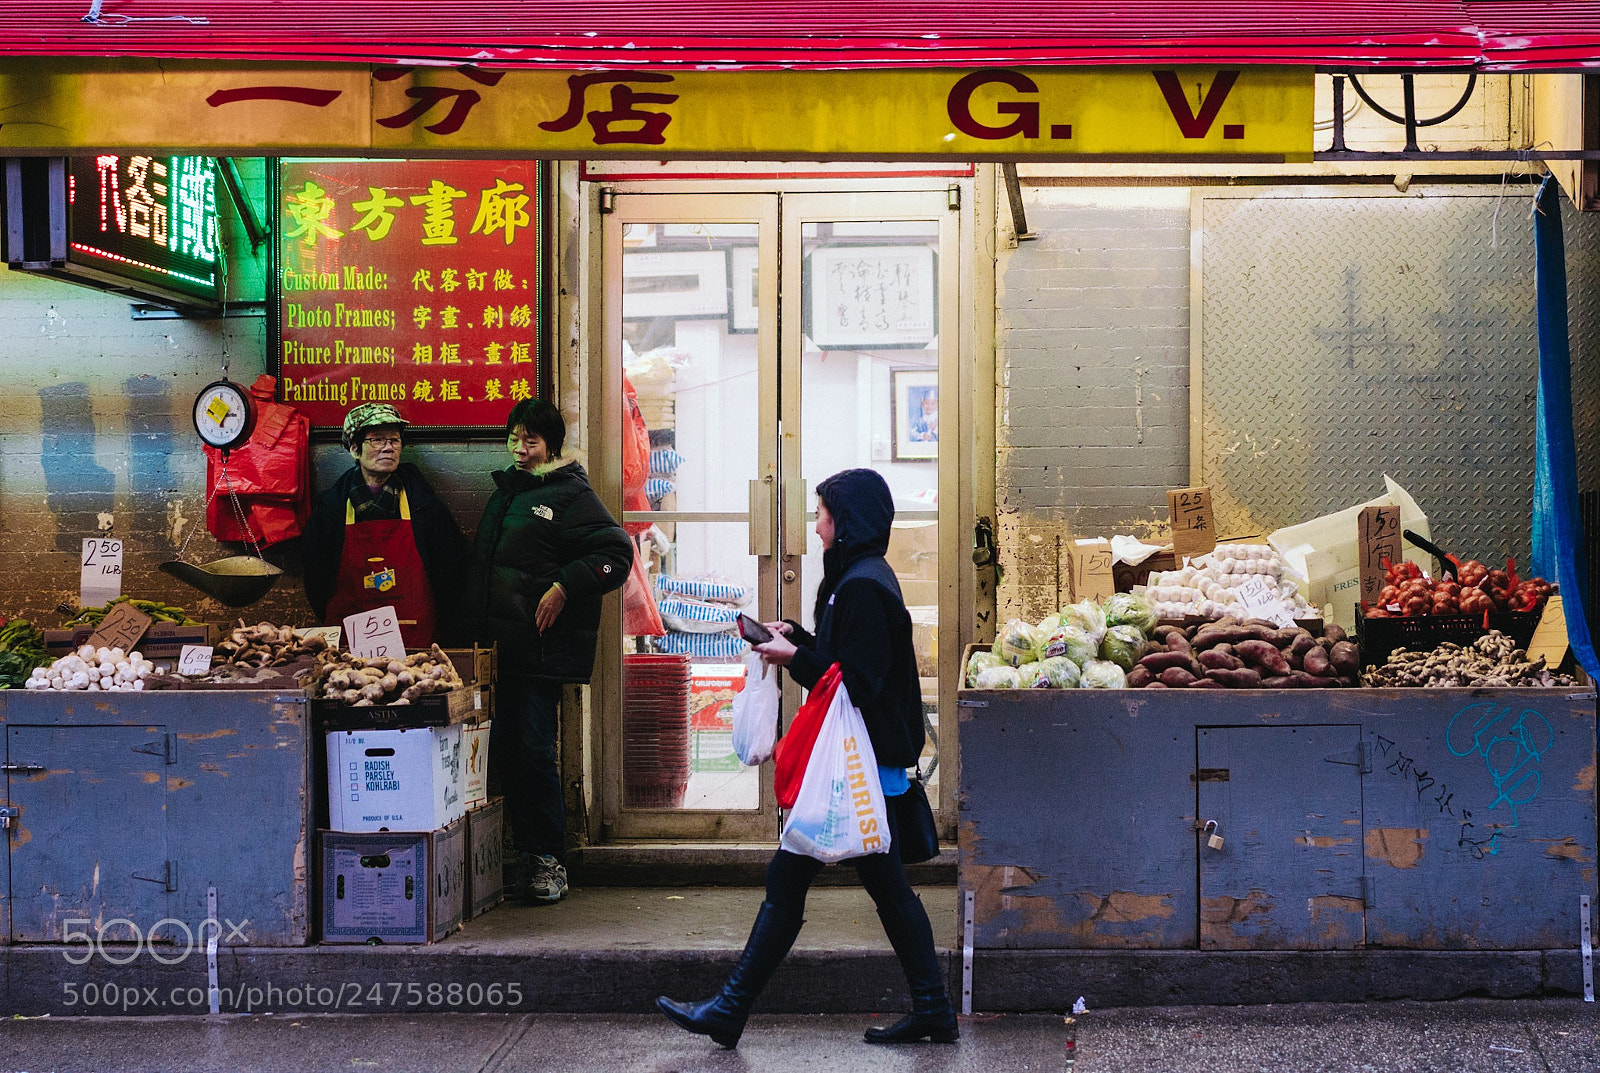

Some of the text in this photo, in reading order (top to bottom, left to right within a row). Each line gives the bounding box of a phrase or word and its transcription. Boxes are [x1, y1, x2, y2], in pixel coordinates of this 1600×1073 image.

[947, 69, 1245, 140] G. V.
[284, 178, 531, 247] 東方畫廊
[283, 265, 388, 291] Custom Made:
[287, 303, 396, 331] Photo Frames;
[283, 340, 396, 368] Piture Frames;
[283, 376, 406, 406] Painting Frames
[364, 761, 390, 770] RADISH
[365, 770, 395, 781] PARSLEY
[365, 781, 400, 791] KOHLRABI
[843, 736, 881, 851] SUNRISE
